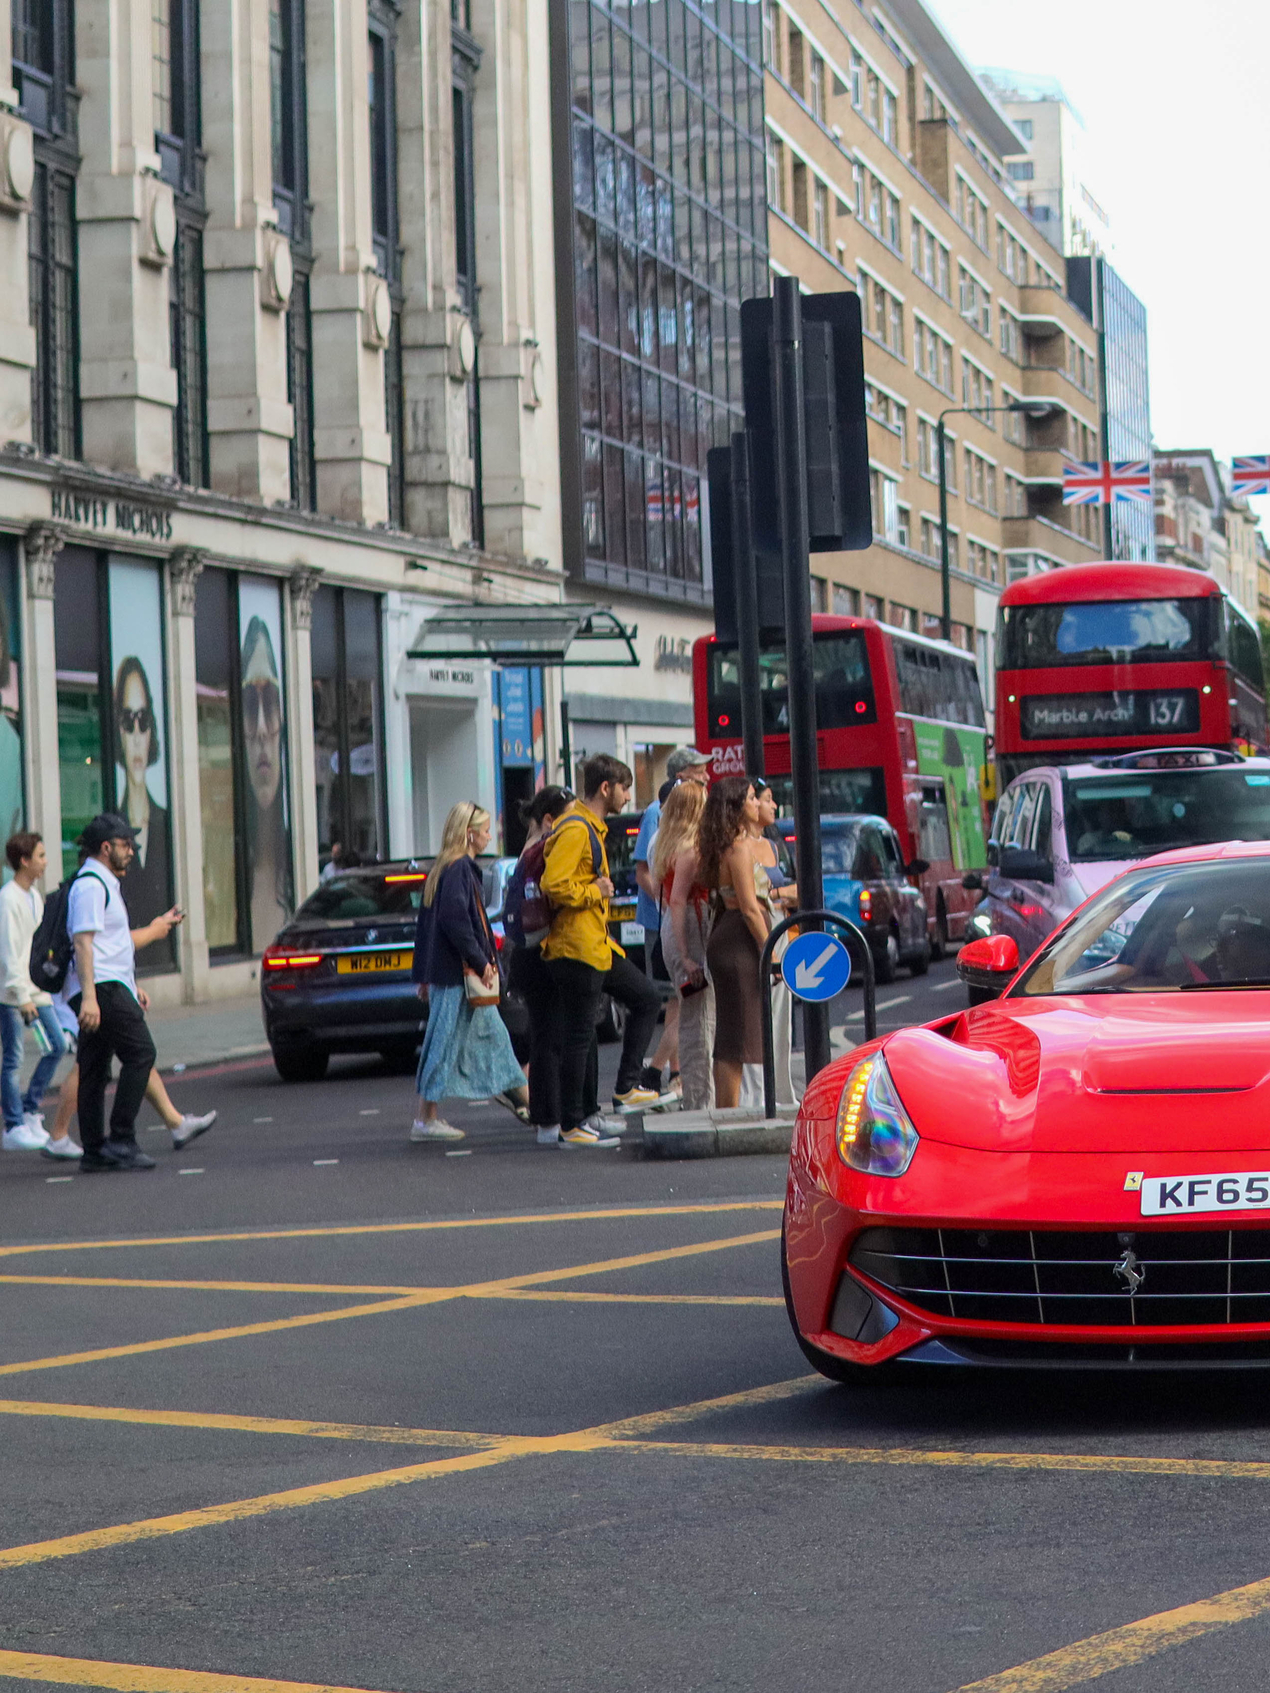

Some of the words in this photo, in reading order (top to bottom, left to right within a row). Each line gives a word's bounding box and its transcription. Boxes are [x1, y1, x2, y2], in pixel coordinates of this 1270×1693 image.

[51, 488, 107, 528] HARVEY
[115, 502, 173, 540] NICHOLS
[1034, 708, 1088, 724] Marble
[1093, 707, 1128, 722] Arch
[1149, 698, 1185, 725] 137
[711, 745, 745, 762] RAT
[1159, 1176, 1269, 1208] KF65
